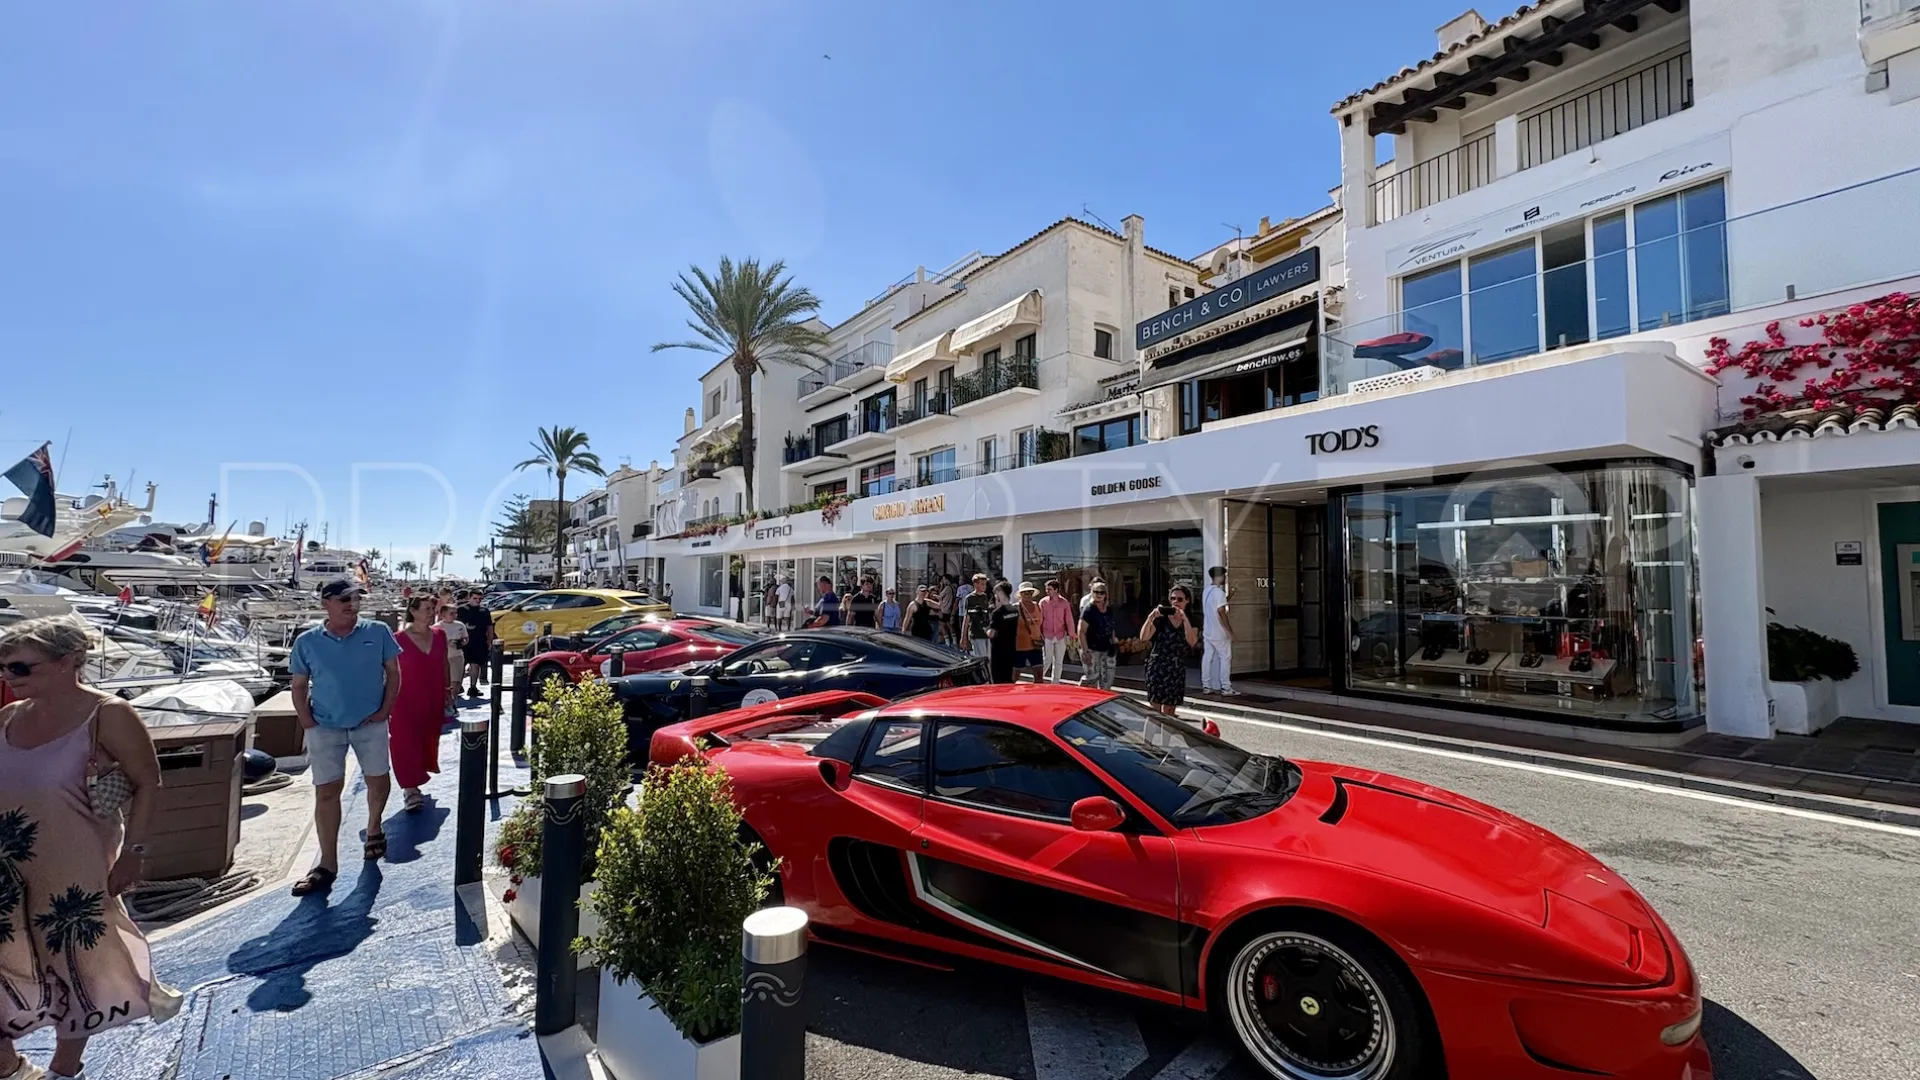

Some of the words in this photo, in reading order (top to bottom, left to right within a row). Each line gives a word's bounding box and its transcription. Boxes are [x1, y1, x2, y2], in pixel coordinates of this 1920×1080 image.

[1658, 162, 1713, 183] Riva
[1415, 244, 1465, 265] VENTURA
[1142, 308, 1193, 340] BENCH
[1200, 301, 1211, 316] &
[1218, 287, 1243, 308] CO
[1256, 262, 1309, 292] LAWYERS
[1236, 348, 1301, 372] benchlaw.es
[1304, 424, 1379, 455] TOD'S
[1091, 481, 1126, 496] GOLDEN
[1129, 476, 1162, 491] GOOSE
[872, 501, 905, 521] GIORGIO
[909, 495, 945, 516] ARMANI
[755, 524, 792, 540] ETRO
